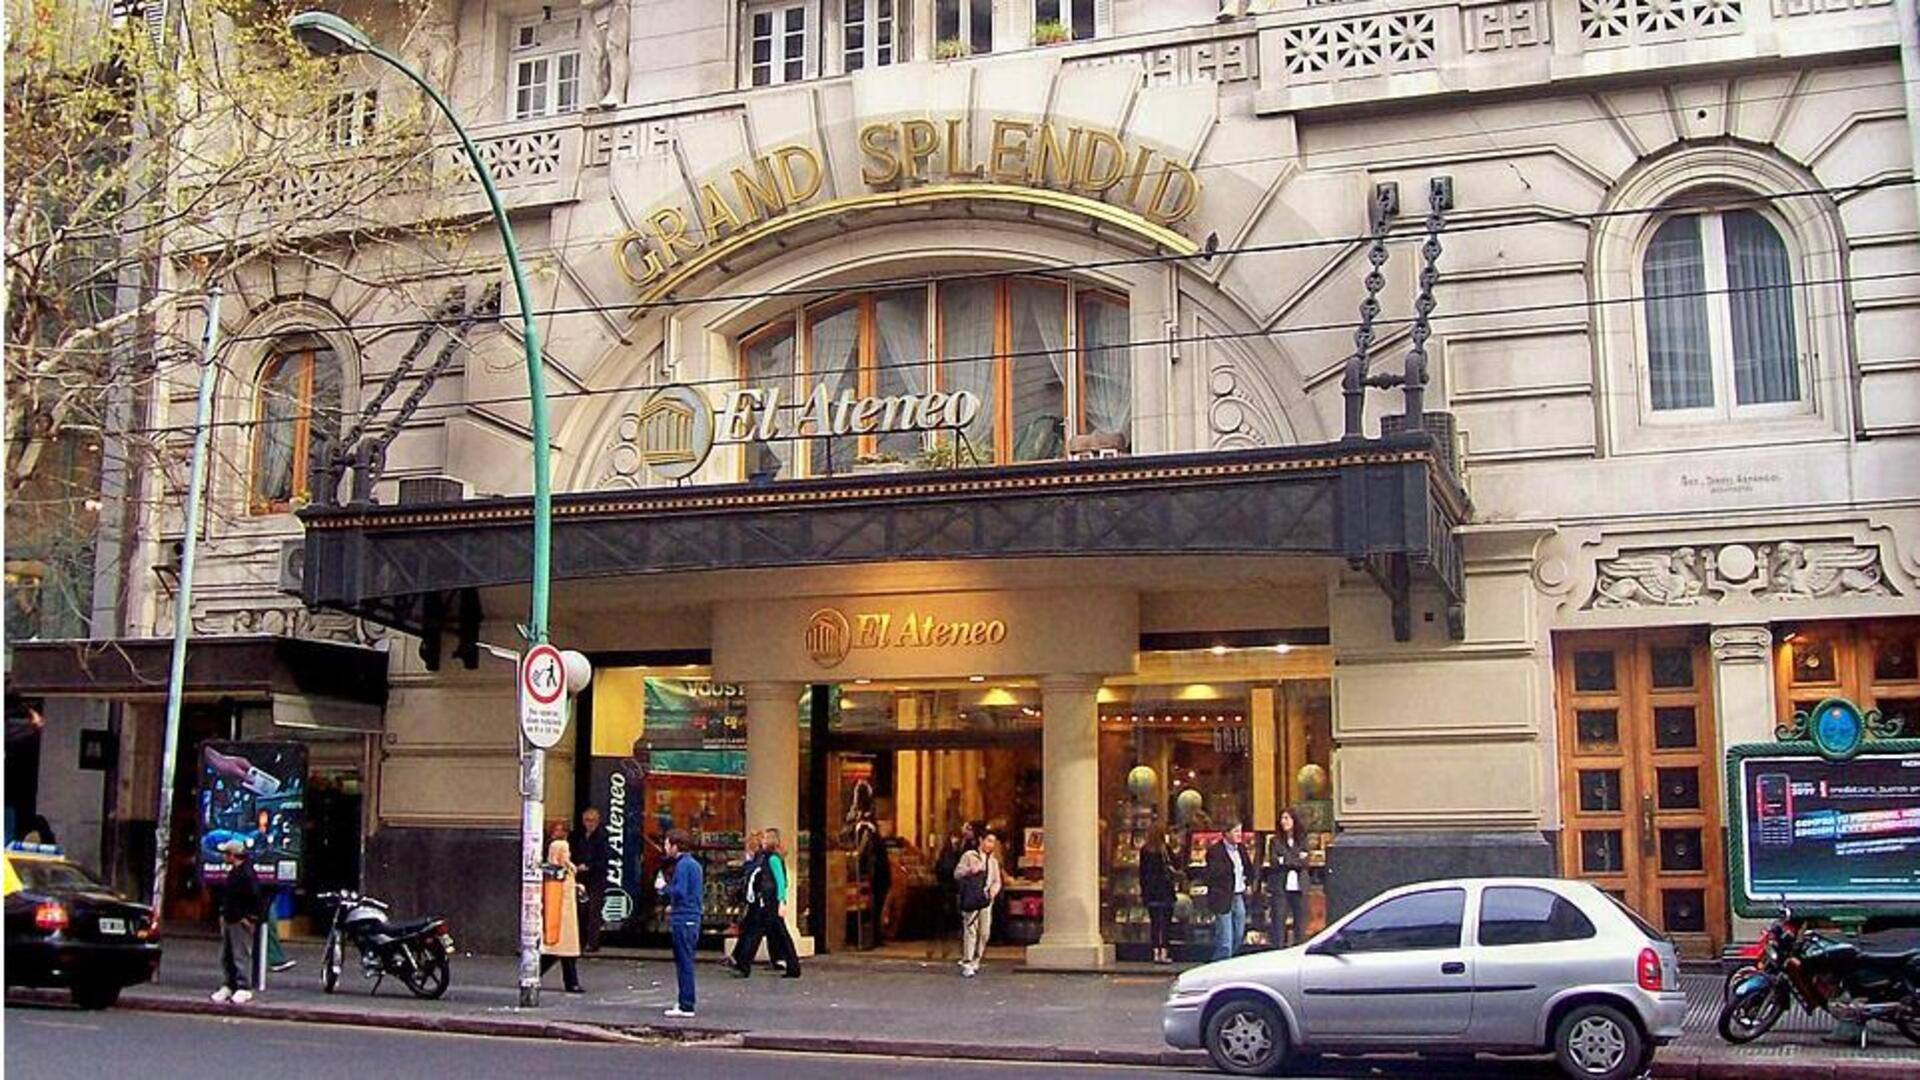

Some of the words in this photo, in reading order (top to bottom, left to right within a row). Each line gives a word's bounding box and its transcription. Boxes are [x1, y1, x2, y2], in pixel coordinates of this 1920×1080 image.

[613, 145, 824, 287] GRAND
[858, 118, 1201, 225] SPLENDID
[717, 387, 781, 442] El
[796, 382, 982, 437] Ateneo
[853, 612, 890, 649] El
[894, 610, 1007, 648] Ateneo
[605, 772, 626, 856] Ateneo
[605, 858, 624, 887] El
